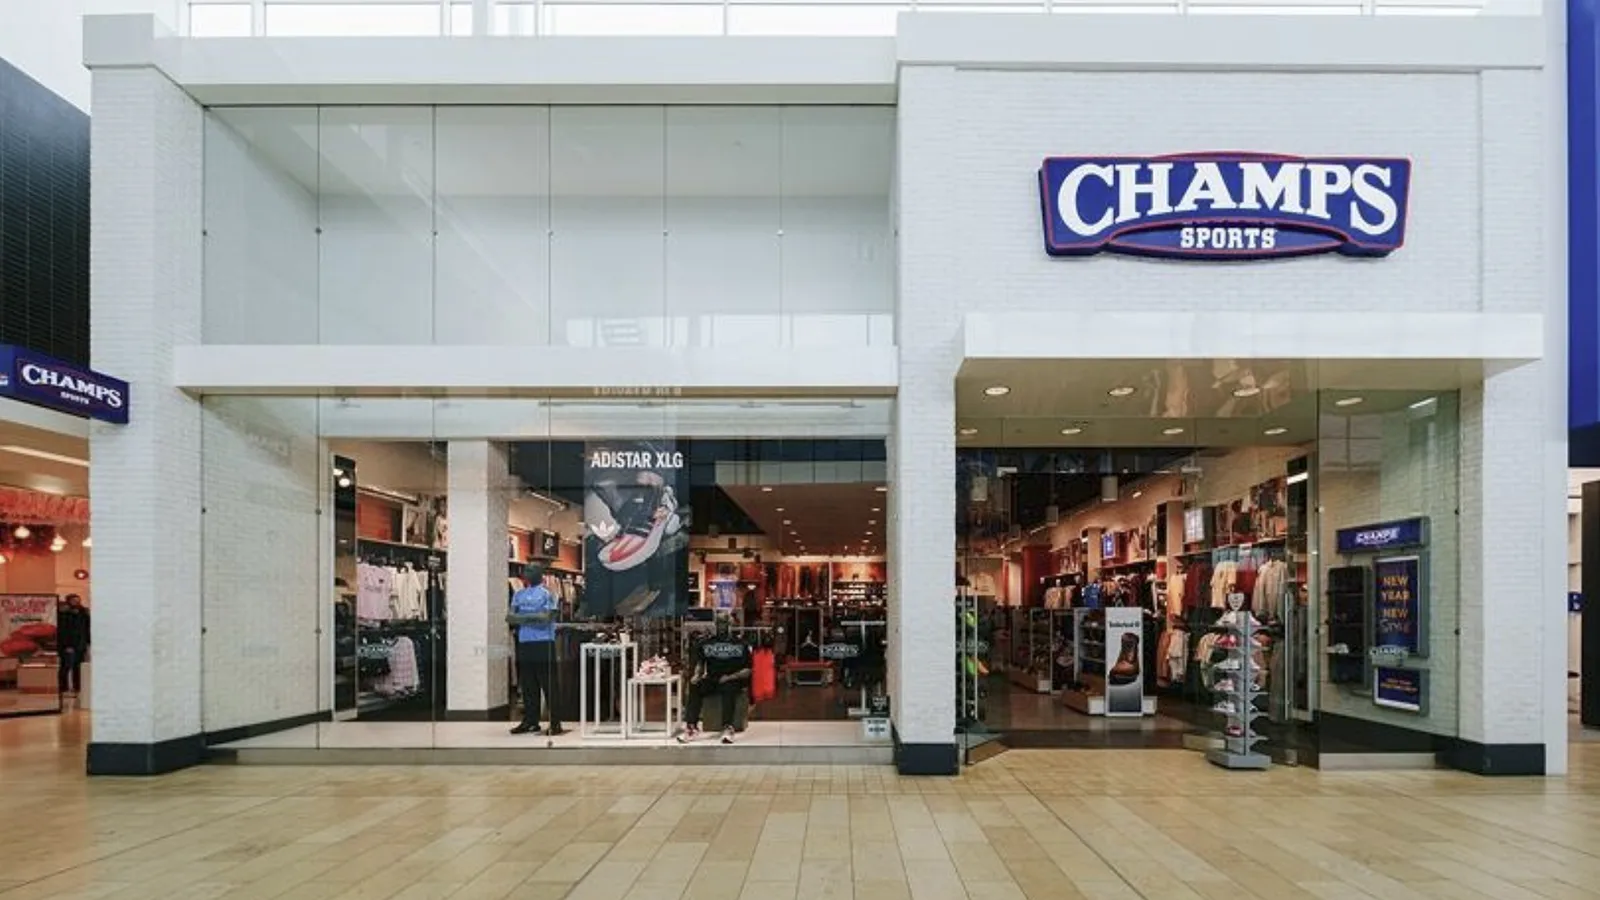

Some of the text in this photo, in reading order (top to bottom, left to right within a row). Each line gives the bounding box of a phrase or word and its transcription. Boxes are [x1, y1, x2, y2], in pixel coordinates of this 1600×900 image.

[1057, 162, 1398, 236] CHAMPS
[1180, 227, 1277, 249] SPORTS
[22, 364, 122, 408] CHAMPS
[590, 451, 684, 468] ADISTAR XLG
[1383, 576, 1409, 586] NEW
[1381, 591, 1410, 601] YEAR
[1383, 608, 1408, 619] NEW
